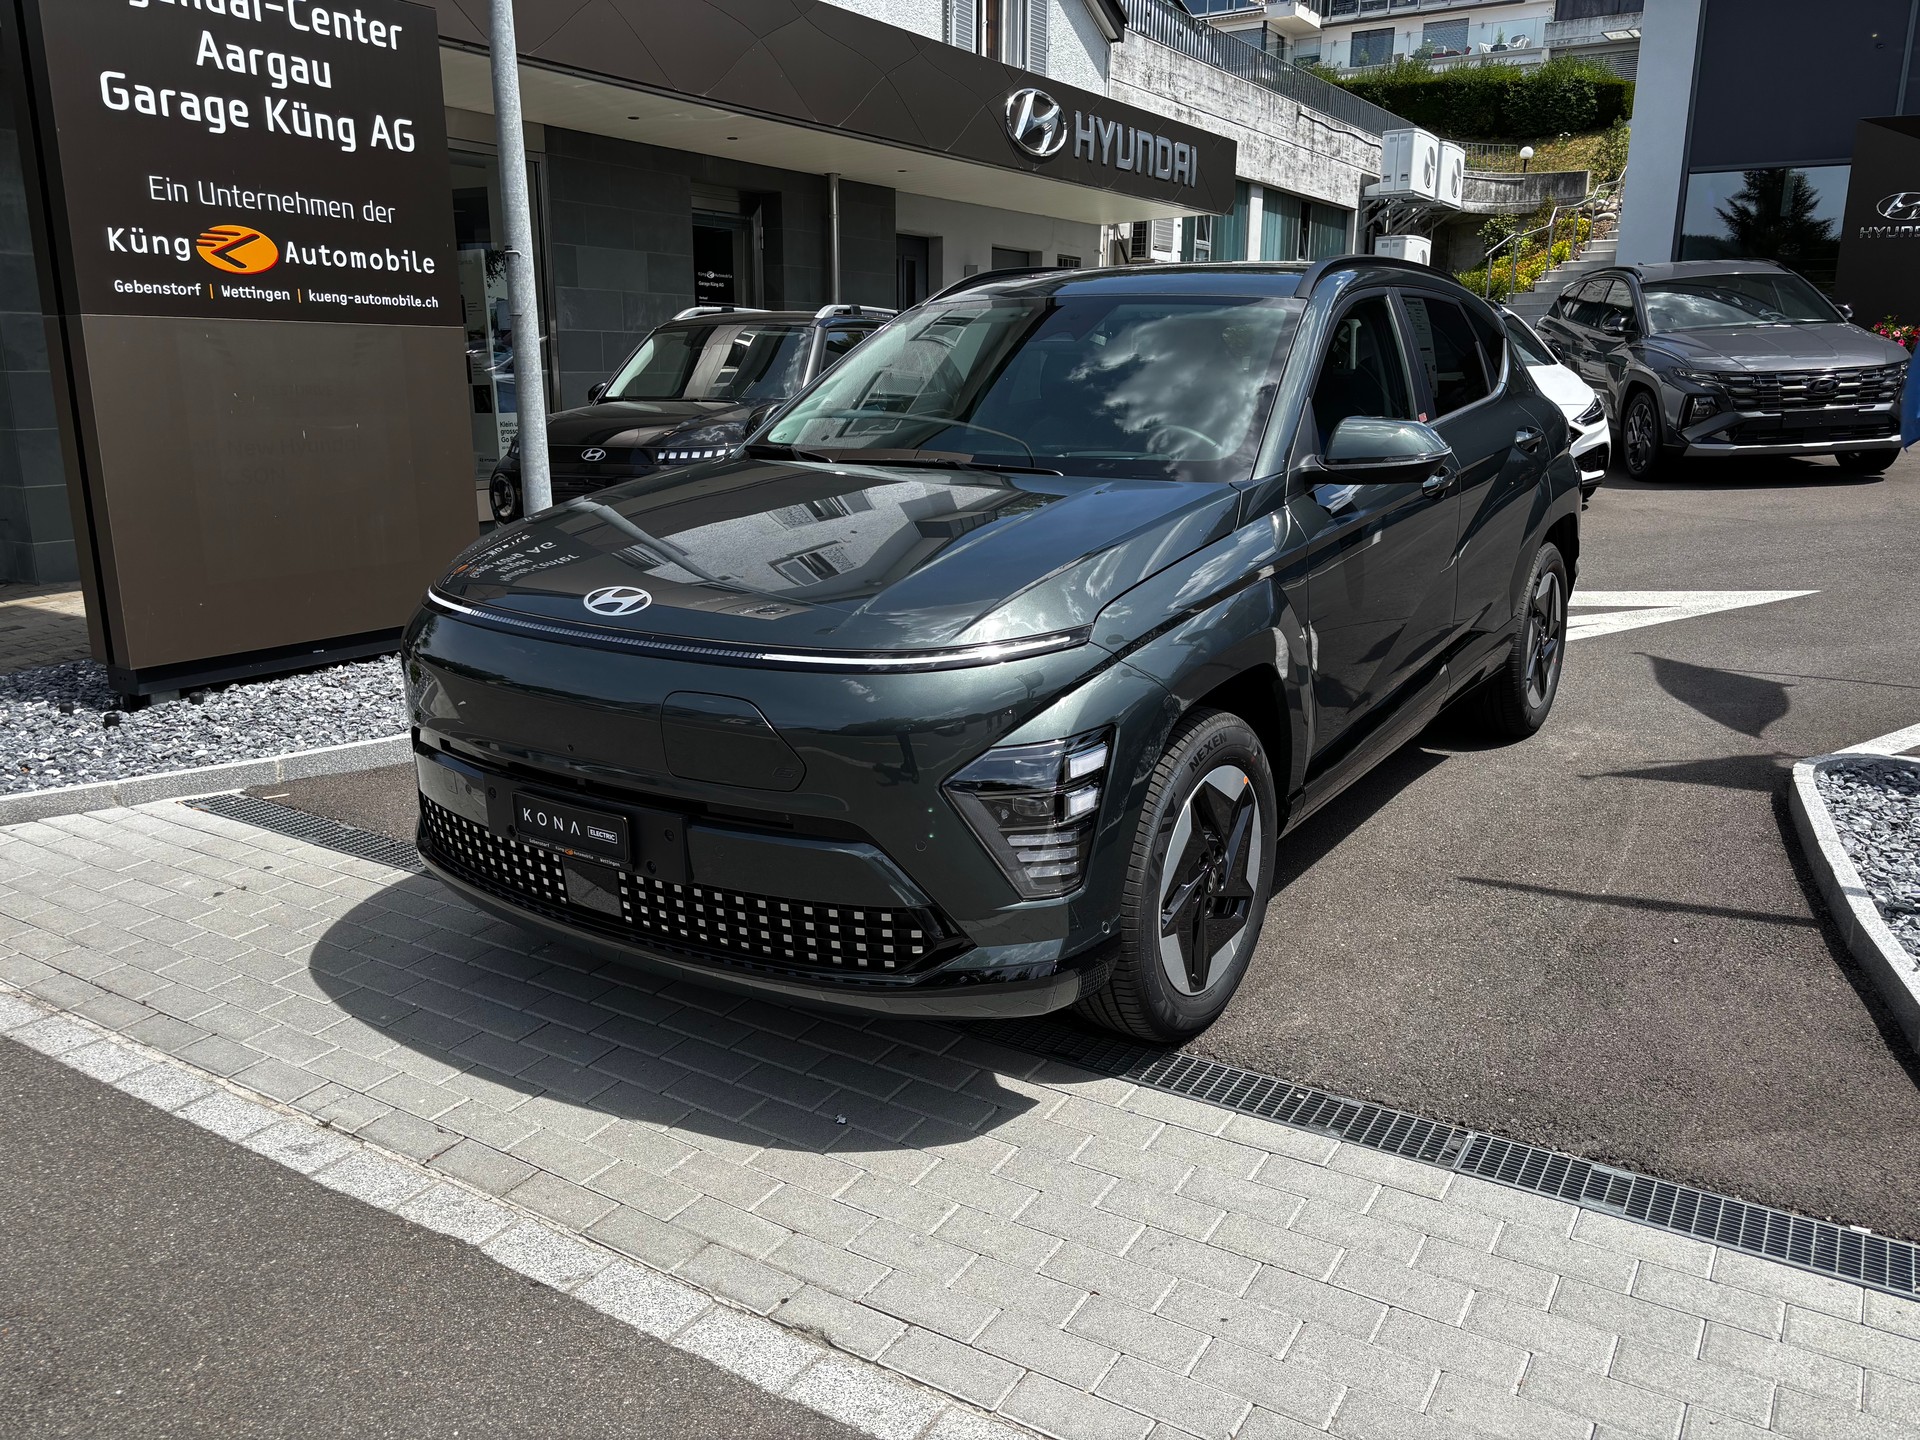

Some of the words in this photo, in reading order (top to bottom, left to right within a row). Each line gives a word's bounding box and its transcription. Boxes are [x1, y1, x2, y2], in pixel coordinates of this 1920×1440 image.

[129, 0, 403, 51] ai-Center
[195, 29, 332, 90] Aargau
[99, 70, 250, 134] Garage
[264, 96, 357, 153] Küng
[370, 114, 415, 153] AG
[1074, 110, 1198, 188] HYUNDAI
[148, 175, 189, 203] Ein
[197, 180, 355, 220] Unternehmen
[362, 199, 396, 224] der
[107, 226, 191, 262] Küng
[285, 241, 435, 274] Automobile
[1859, 226, 1920, 239] HYUN
[113, 279, 202, 296] Gebenstorf
[220, 284, 291, 303] Wettingen
[308, 288, 439, 308] kueng-automobile.ch
[1188, 732, 1228, 773] NEXEN
[523, 807, 581, 836] KONA
[589, 828, 616, 841] ELECTRIC
